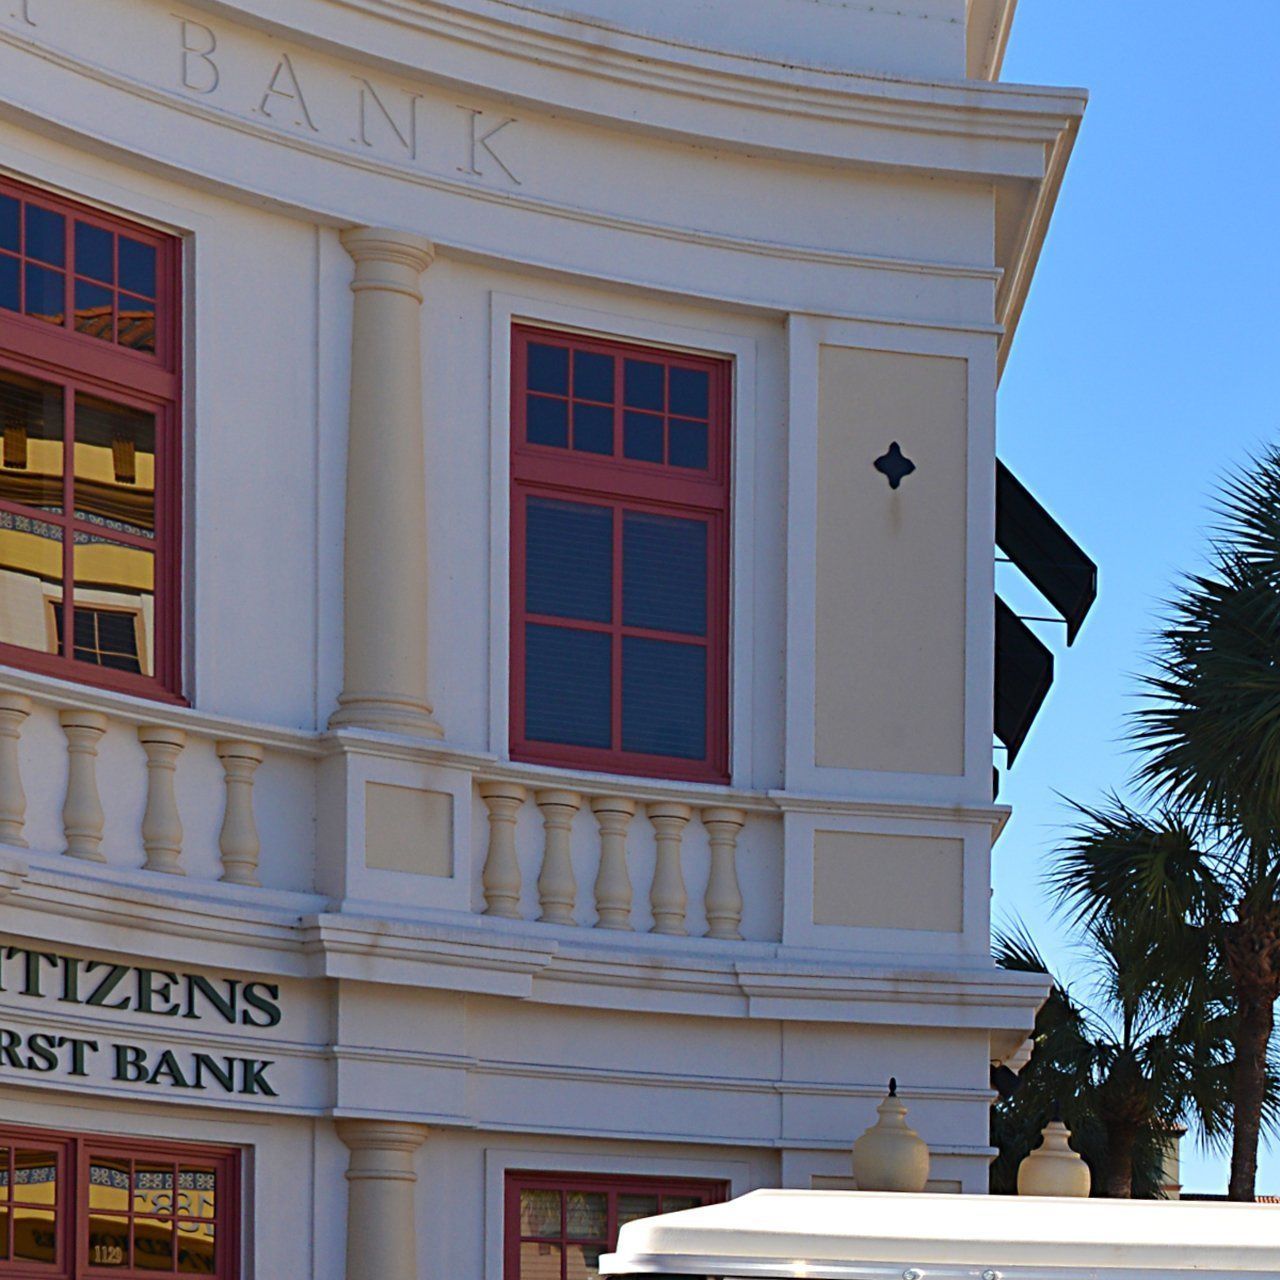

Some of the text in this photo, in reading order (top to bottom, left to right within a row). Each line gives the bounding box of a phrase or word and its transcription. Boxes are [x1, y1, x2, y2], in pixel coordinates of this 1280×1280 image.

[170, 12, 522, 185] BANK
[113, 1044, 278, 1097] BANK
[94, 1246, 123, 1264] 1129
